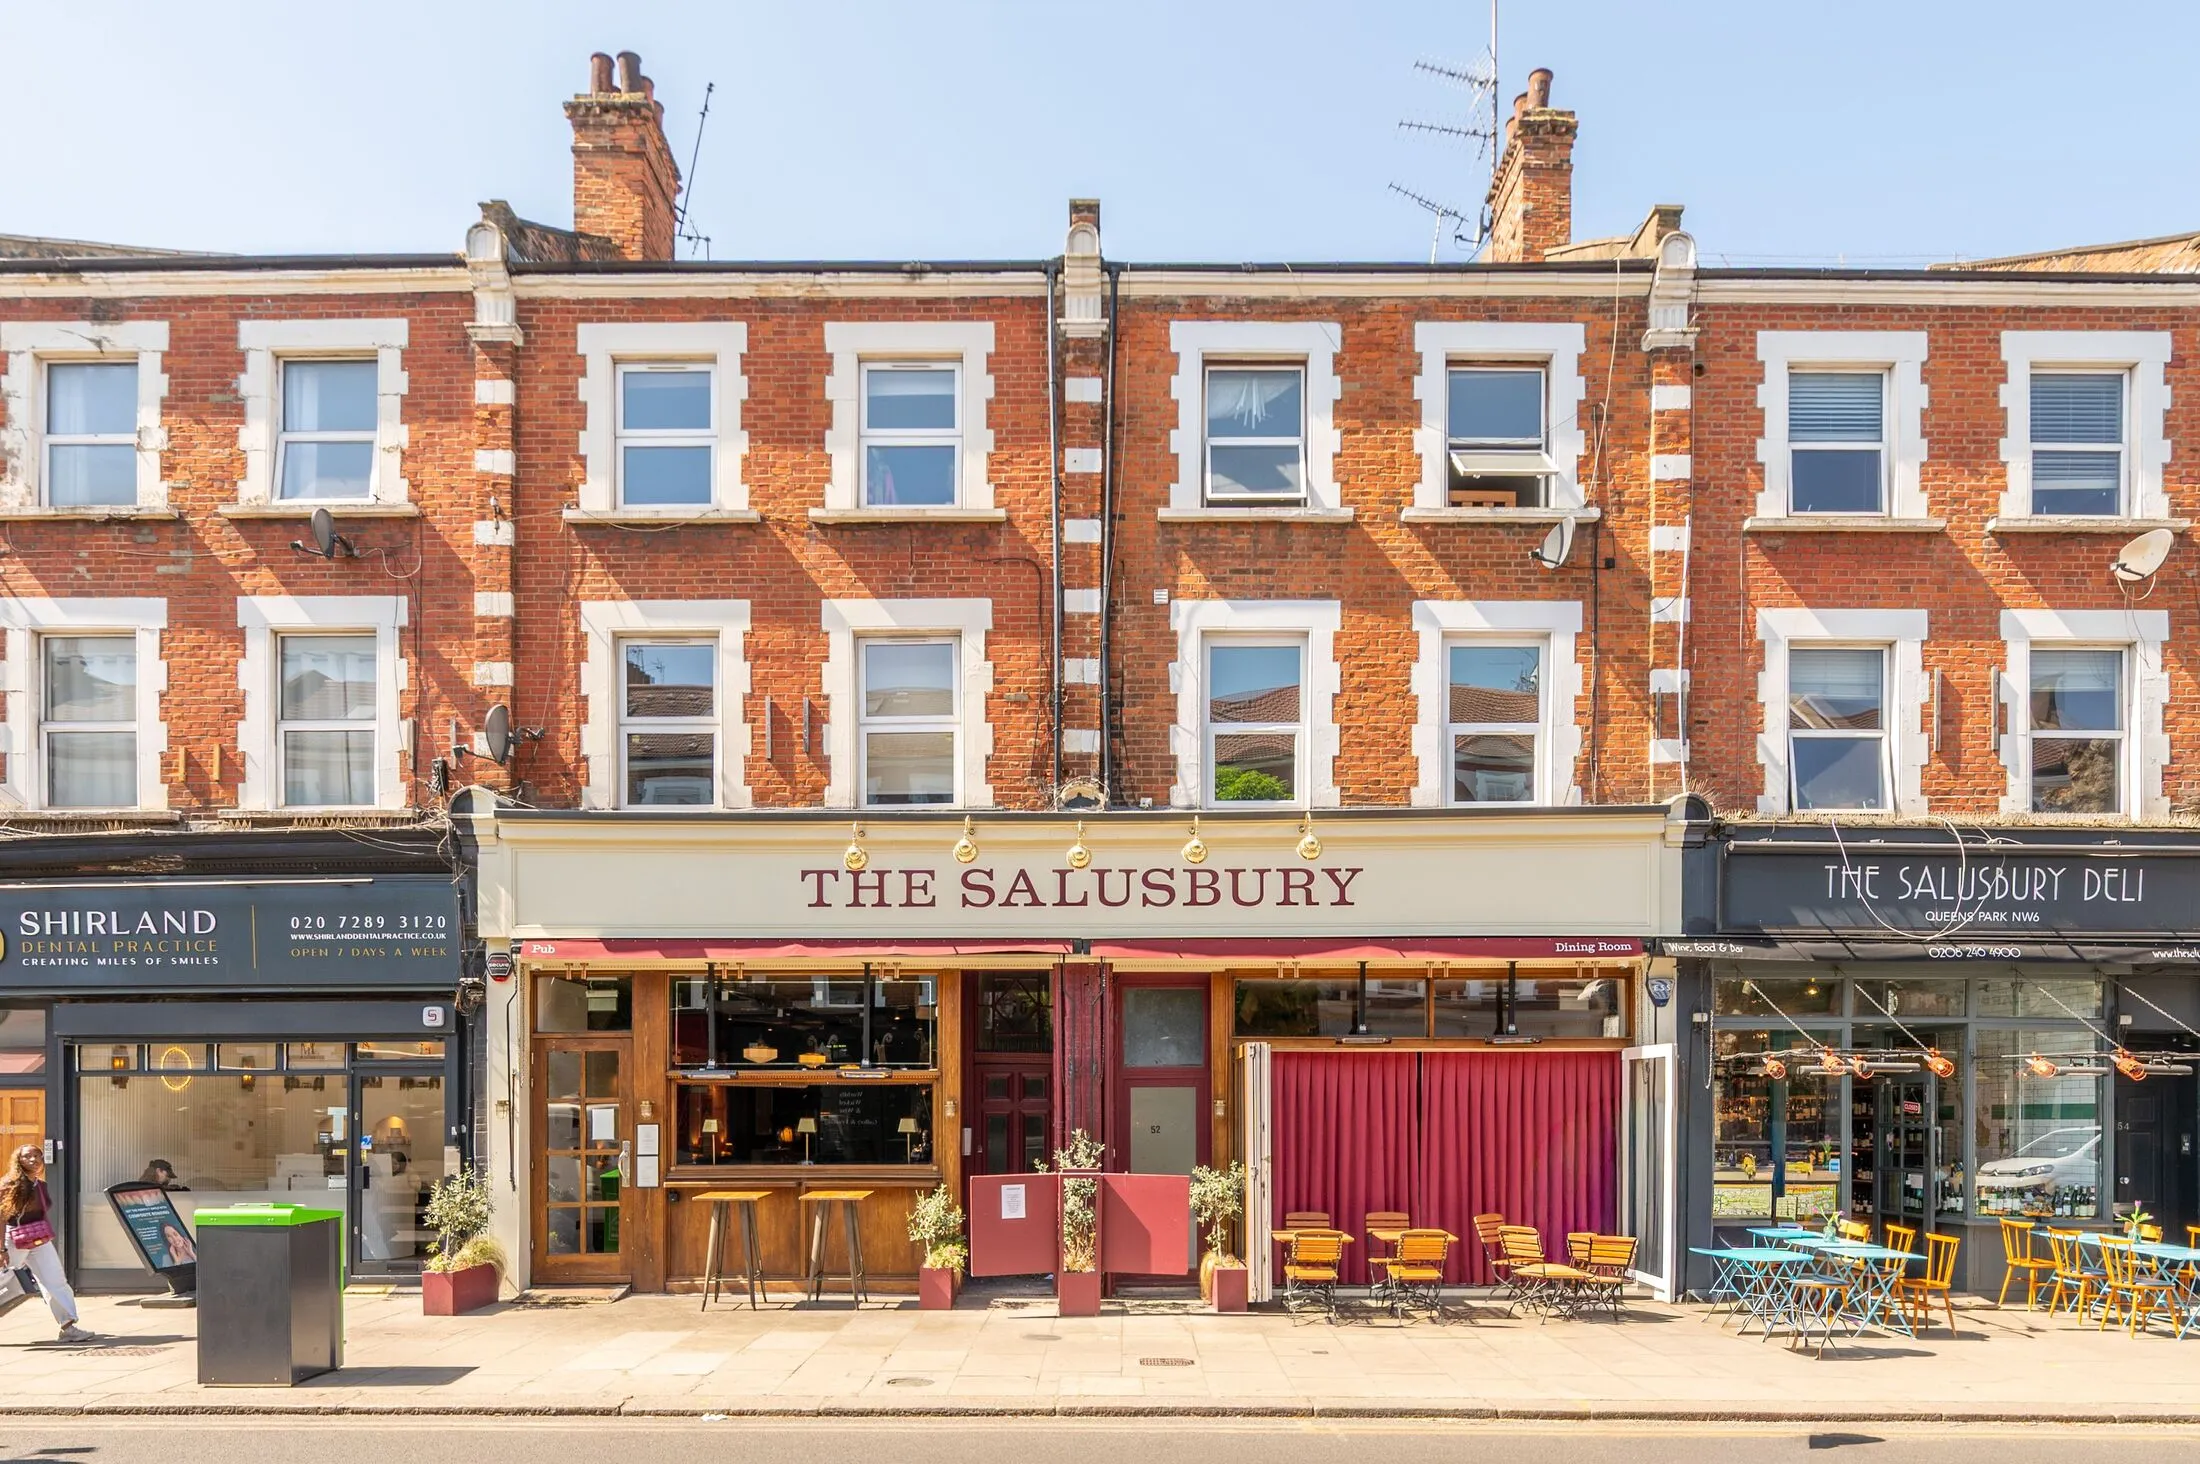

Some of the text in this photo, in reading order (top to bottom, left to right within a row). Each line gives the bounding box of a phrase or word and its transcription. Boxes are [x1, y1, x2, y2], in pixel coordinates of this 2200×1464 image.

[801, 868, 1364, 908] THE SALUSBURY
[1825, 865, 2144, 902] THE SALUSBURY DELI
[290, 915, 446, 929] 020 7289 3120
[1925, 911, 2040, 922] QUEENS PARK NW6
[20, 910, 217, 936] SHIRLAND
[290, 932, 447, 941] WWW.SHIRLANDDENTALPRACTICE.CO.UK
[21, 939, 217, 953] DENTAL PRACTICE
[531, 944, 555, 954] Pub
[1555, 942, 1632, 954] Dining Room
[1719, 942, 1727, 953] &
[291, 947, 447, 957] OPEN 7 DAYS A WEEK
[1928, 947, 1963, 958] 0208
[1989, 947, 2021, 958] 4900
[22, 956, 219, 966] CREATING MILES OF SMILES
[1150, 1125, 1161, 1134] 52
[2118, 1122, 2129, 1130] 54
